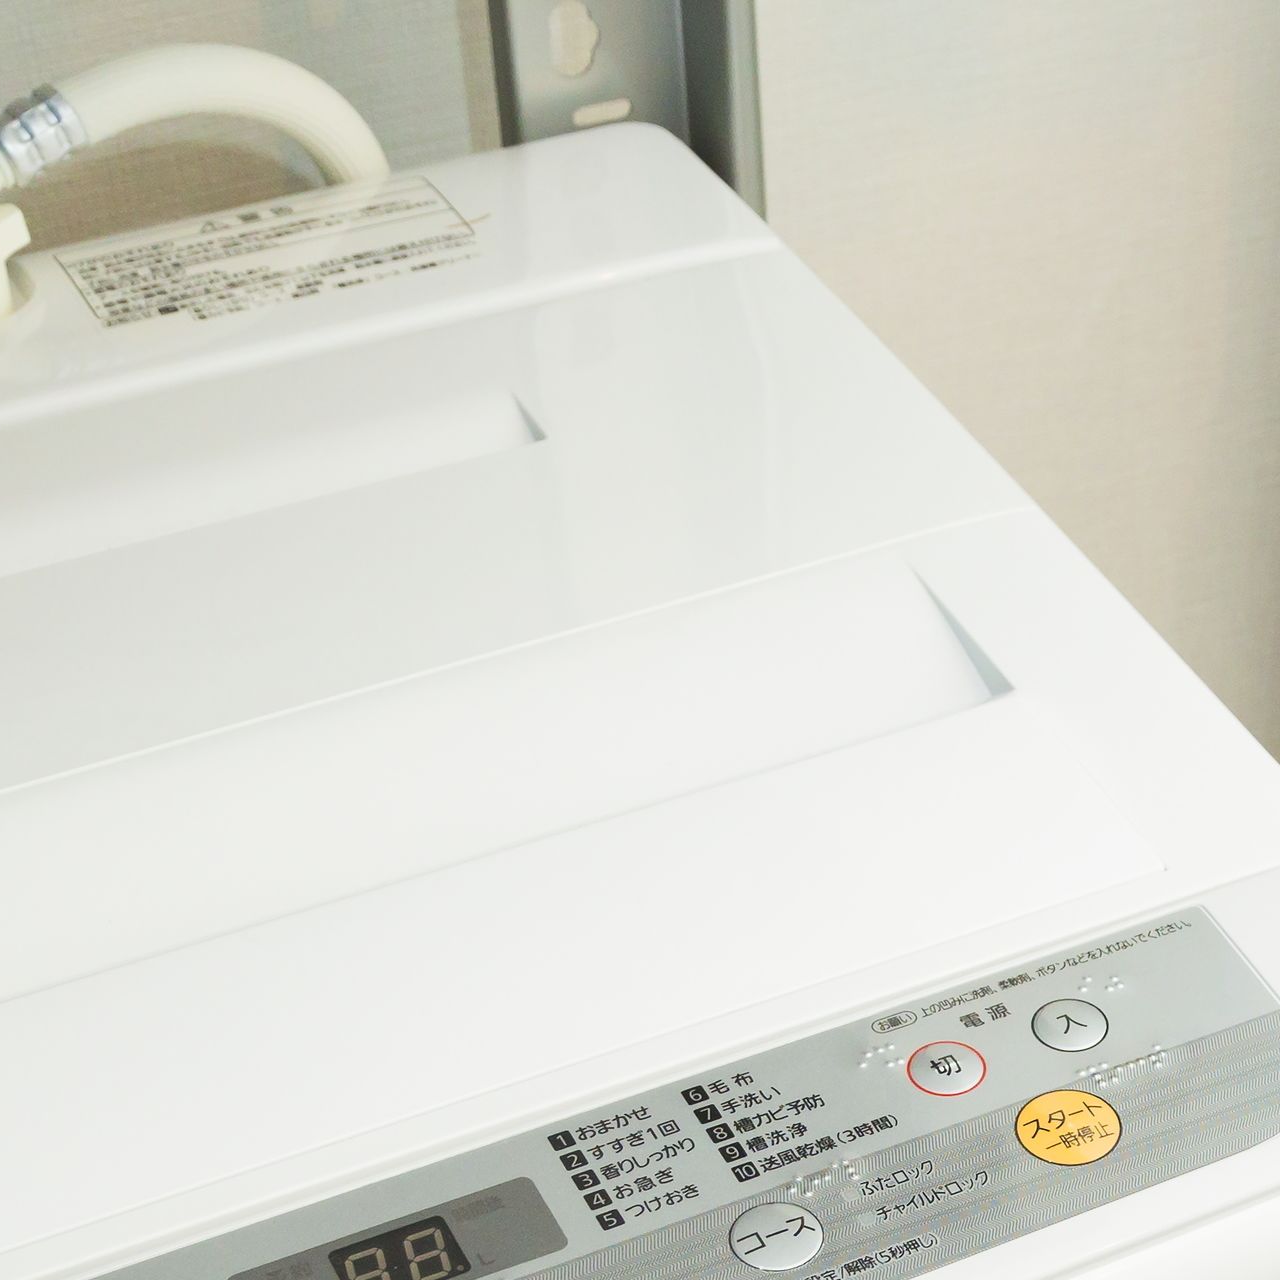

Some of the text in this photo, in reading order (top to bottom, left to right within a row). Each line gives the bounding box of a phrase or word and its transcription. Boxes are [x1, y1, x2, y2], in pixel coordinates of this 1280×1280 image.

[876, 1013, 914, 1033] お願い
[959, 1002, 1012, 1029] 電源
[1056, 1013, 1088, 1035] 入
[707, 1071, 755, 1095] 毛布
[928, 1054, 962, 1077] 切
[720, 1085, 782, 1115] 手洗い
[733, 1093, 826, 1134] 槽カビ予防
[575, 1105, 652, 1141] おまかせ
[745, 1121, 808, 1154] 槽洗浄
[1022, 1101, 1103, 1139] スタート
[1045, 1121, 1114, 1151] 一時停止
[587, 1119, 681, 1160] すすぎ1回
[757, 1113, 899, 1174] 送風乾燥(3時間)
[599, 1137, 696, 1180] 香りしっかり
[612, 1166, 675, 1200] お急ぎ
[860, 1159, 934, 1197] ふたロック
[875, 1170, 989, 1221] チャイルドロック
[624, 1183, 700, 1218] つけおき
[736, 1215, 816, 1255] コース
